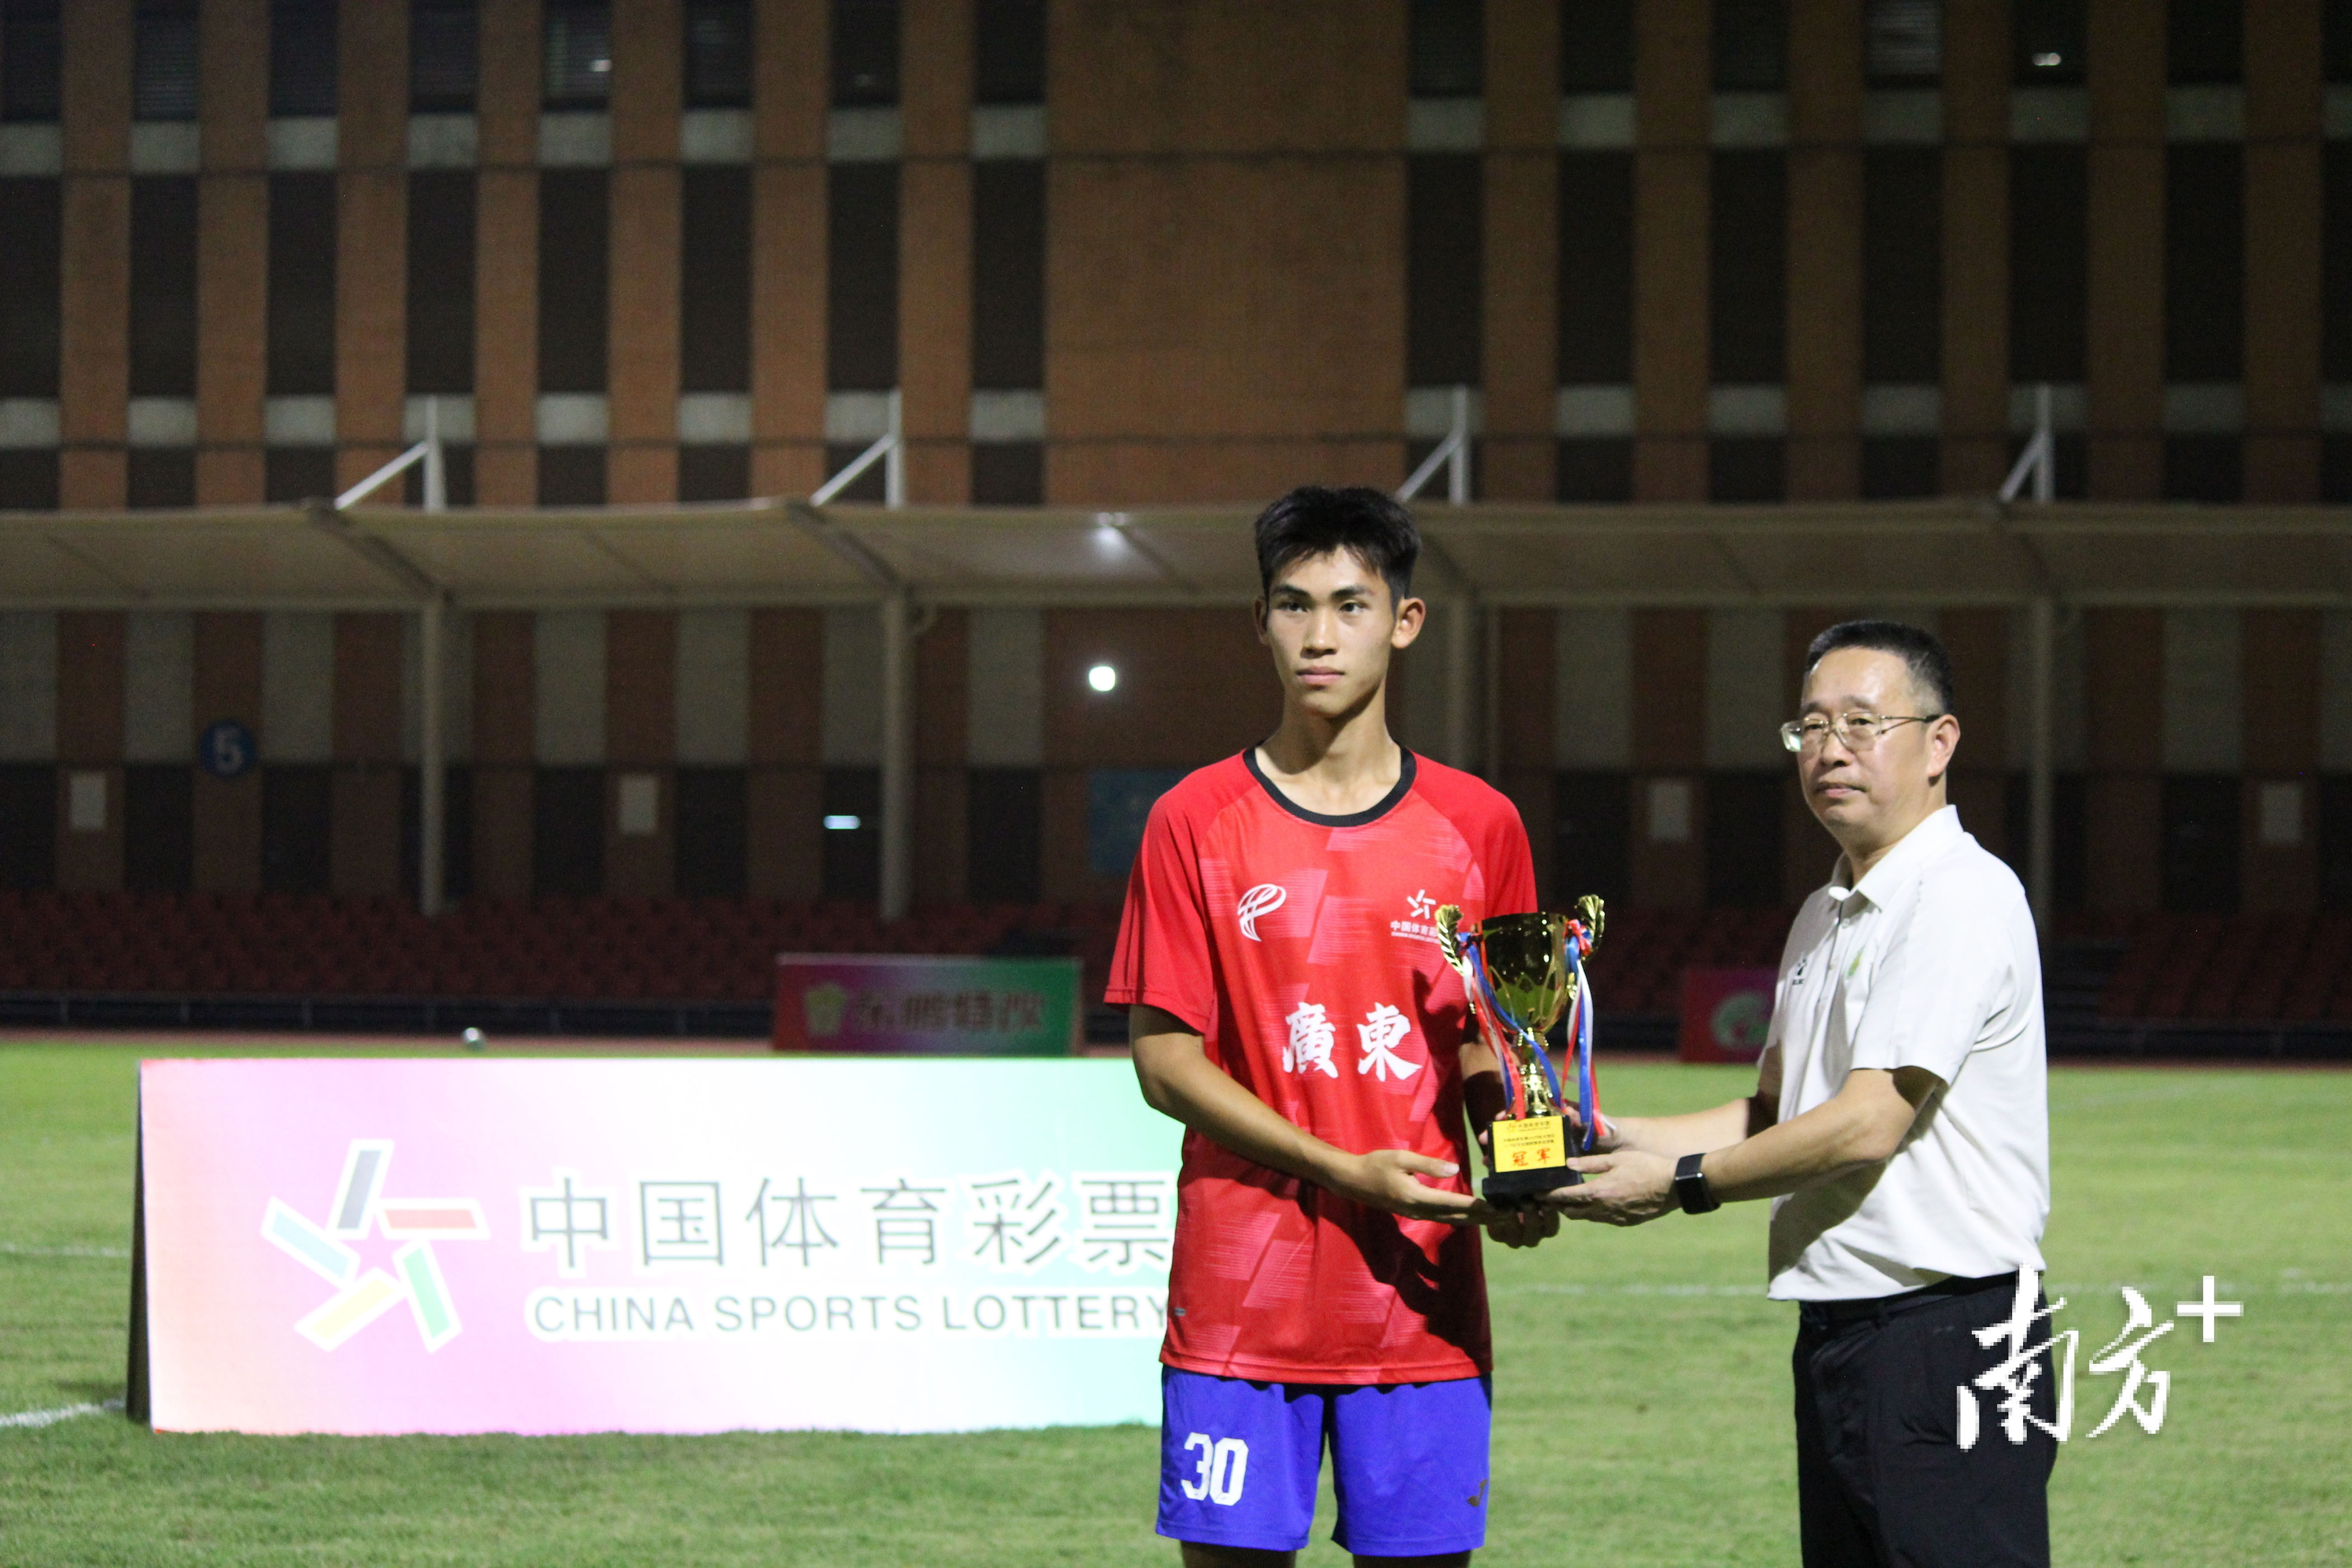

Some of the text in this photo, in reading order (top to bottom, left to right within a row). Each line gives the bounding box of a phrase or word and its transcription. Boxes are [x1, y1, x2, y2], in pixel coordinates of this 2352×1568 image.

[215, 728, 244, 773] 5
[1282, 1001, 1423, 1082] 廣東
[529, 1177, 1170, 1268] 中国体育彩票
[535, 1295, 1168, 1332] CHINA SPORTS LOTTERY
[1180, 1432, 1249, 1506] 30
